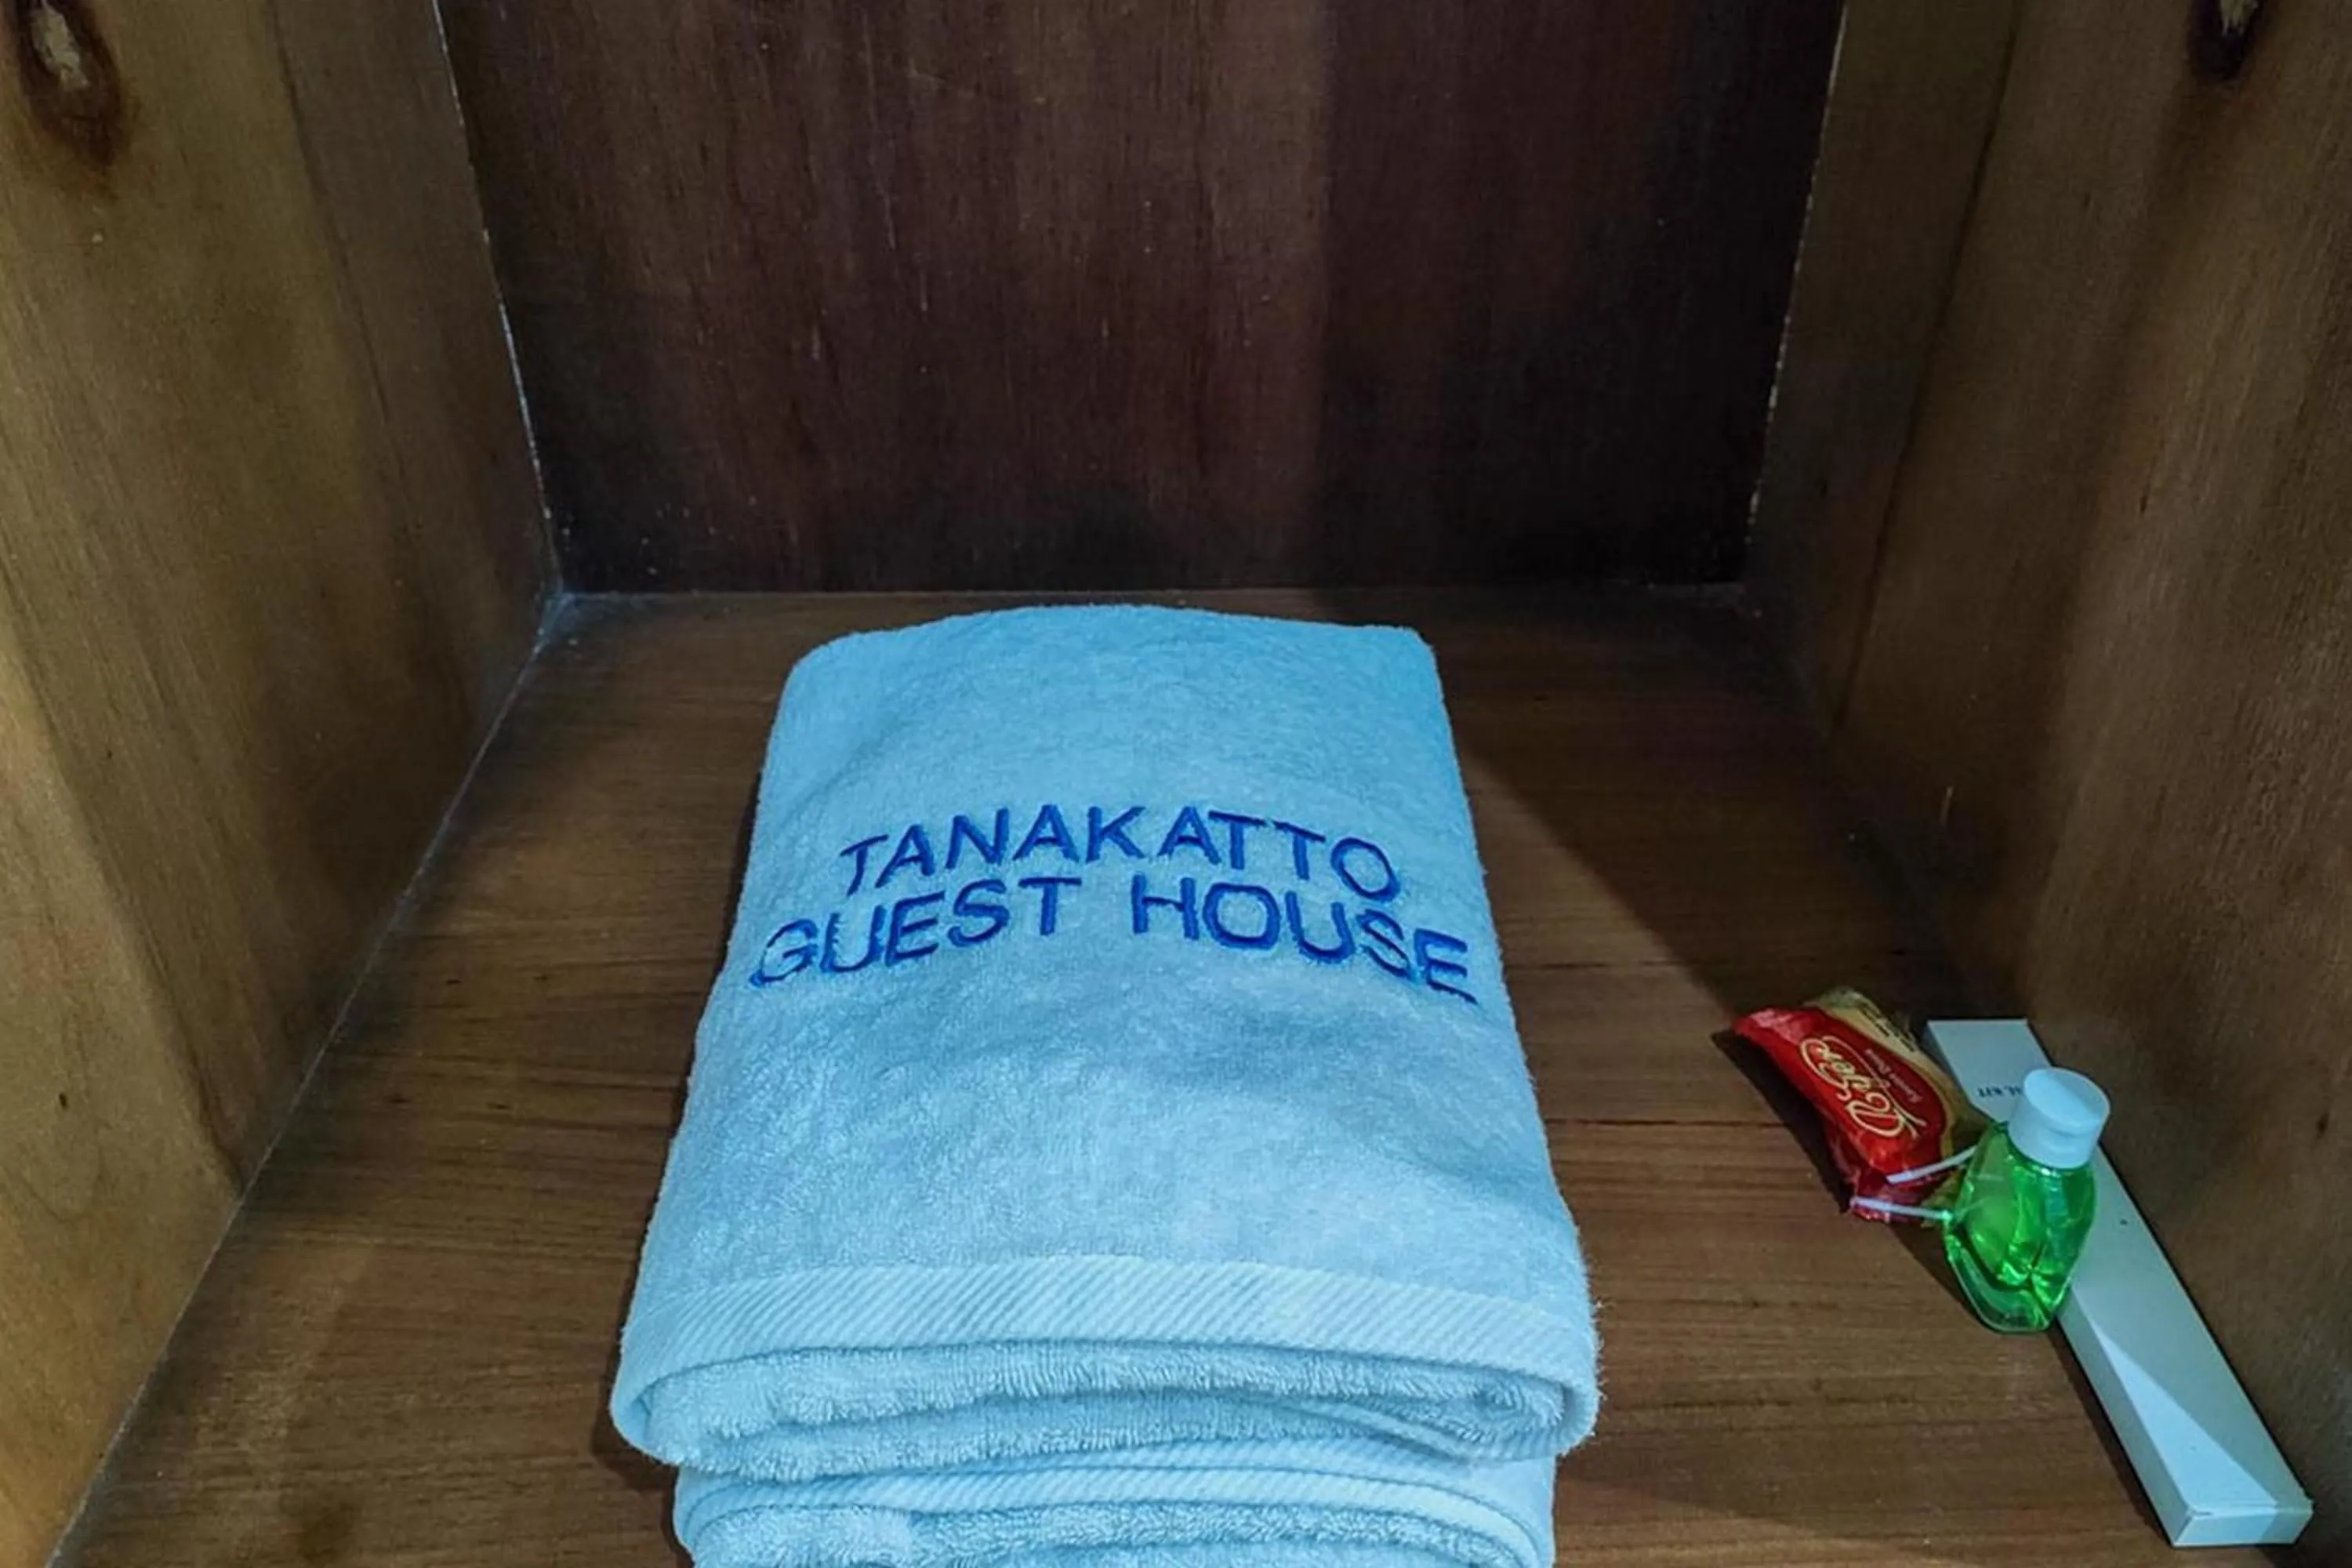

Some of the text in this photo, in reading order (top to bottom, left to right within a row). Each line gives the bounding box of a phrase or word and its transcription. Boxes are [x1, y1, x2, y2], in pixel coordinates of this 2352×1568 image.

[839, 803, 1402, 905] TANAKATTO
[748, 873, 1479, 1006] GUEST HOUSE
